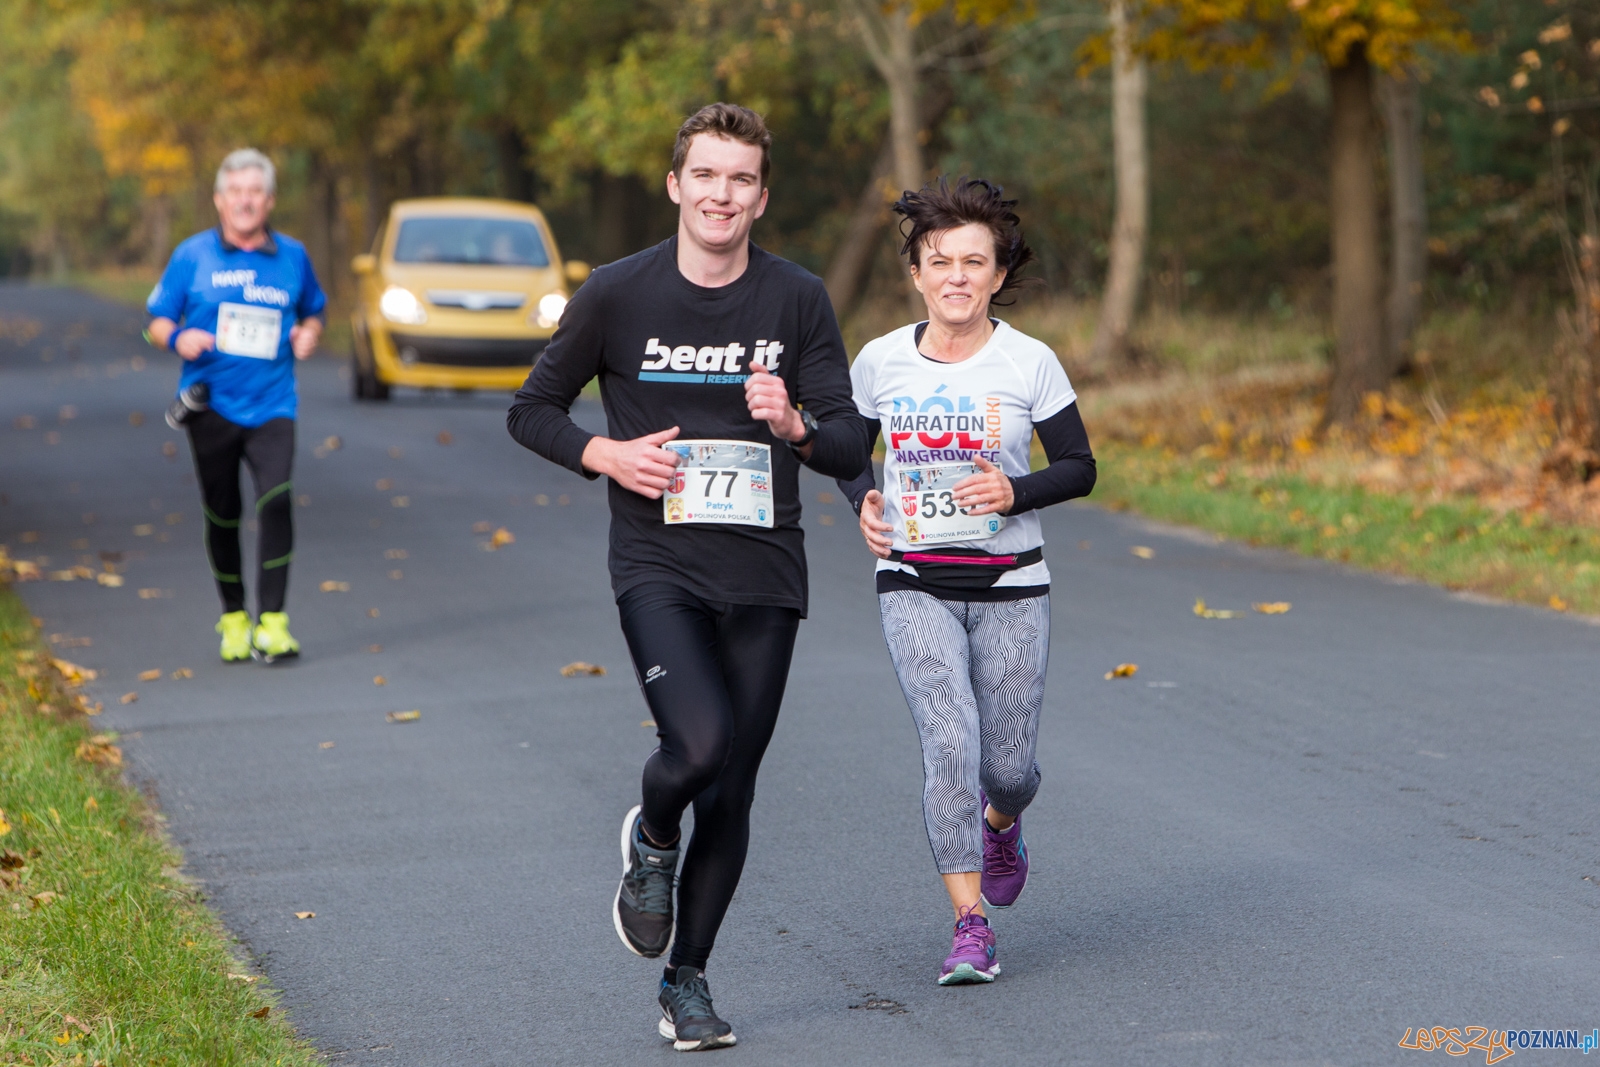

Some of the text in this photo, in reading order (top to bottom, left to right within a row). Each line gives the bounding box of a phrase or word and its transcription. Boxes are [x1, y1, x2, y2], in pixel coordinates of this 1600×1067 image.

[641, 338, 784, 373] beat it
[890, 415, 984, 432] MARATON
[986, 397, 1001, 449] SKOKI
[894, 449, 1000, 466] WĄGROWEC
[700, 470, 738, 497] 77
[706, 501, 733, 511] Patryk
